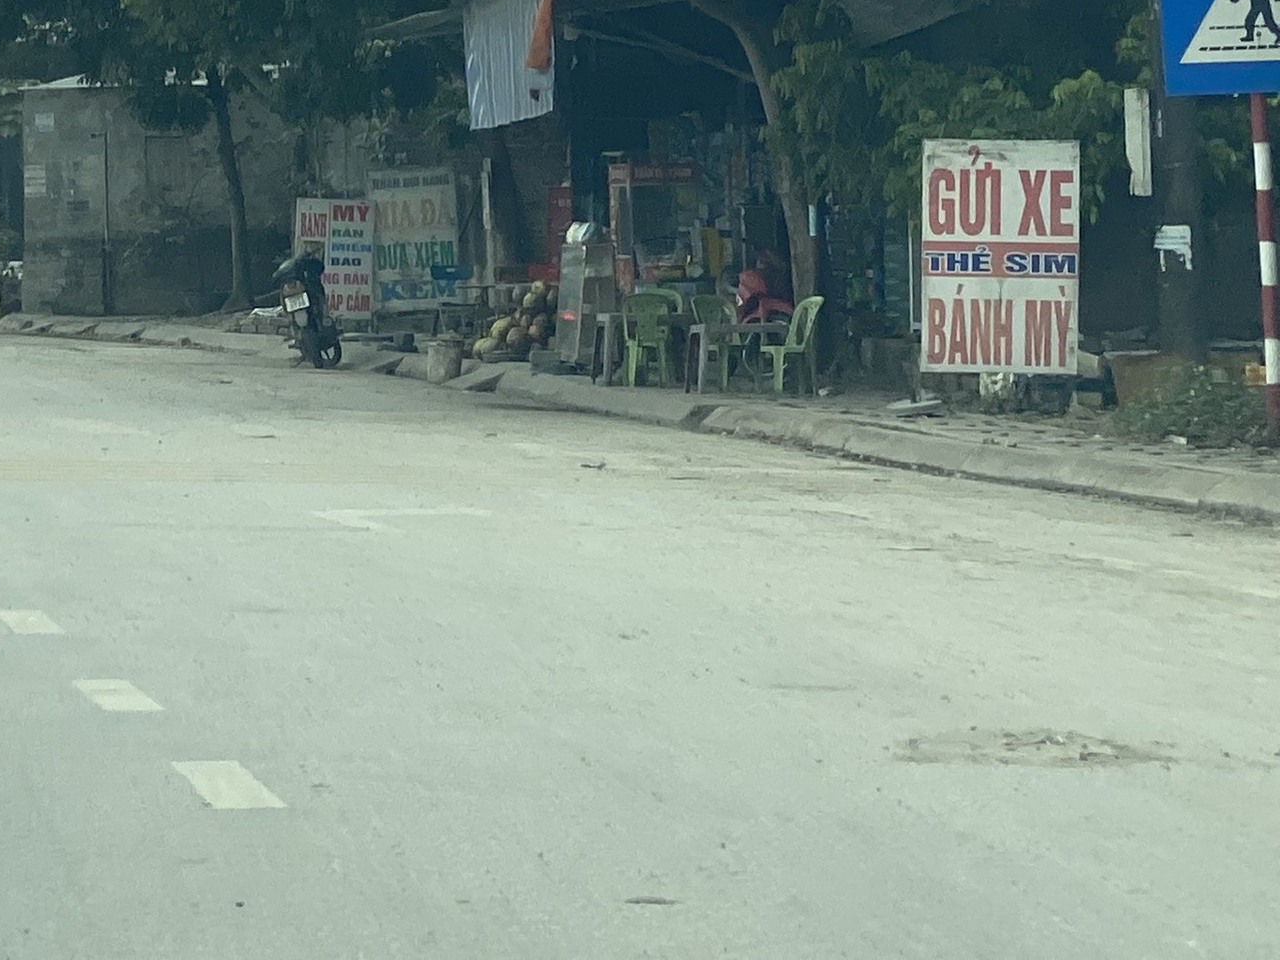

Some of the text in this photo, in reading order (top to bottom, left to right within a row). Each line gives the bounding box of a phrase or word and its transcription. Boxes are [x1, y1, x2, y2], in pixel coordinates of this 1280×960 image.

[928, 145, 1075, 237] GỬI XE
[924, 246, 1078, 274] THẺ SIM
[927, 283, 1071, 367] BÁNH MỲ
